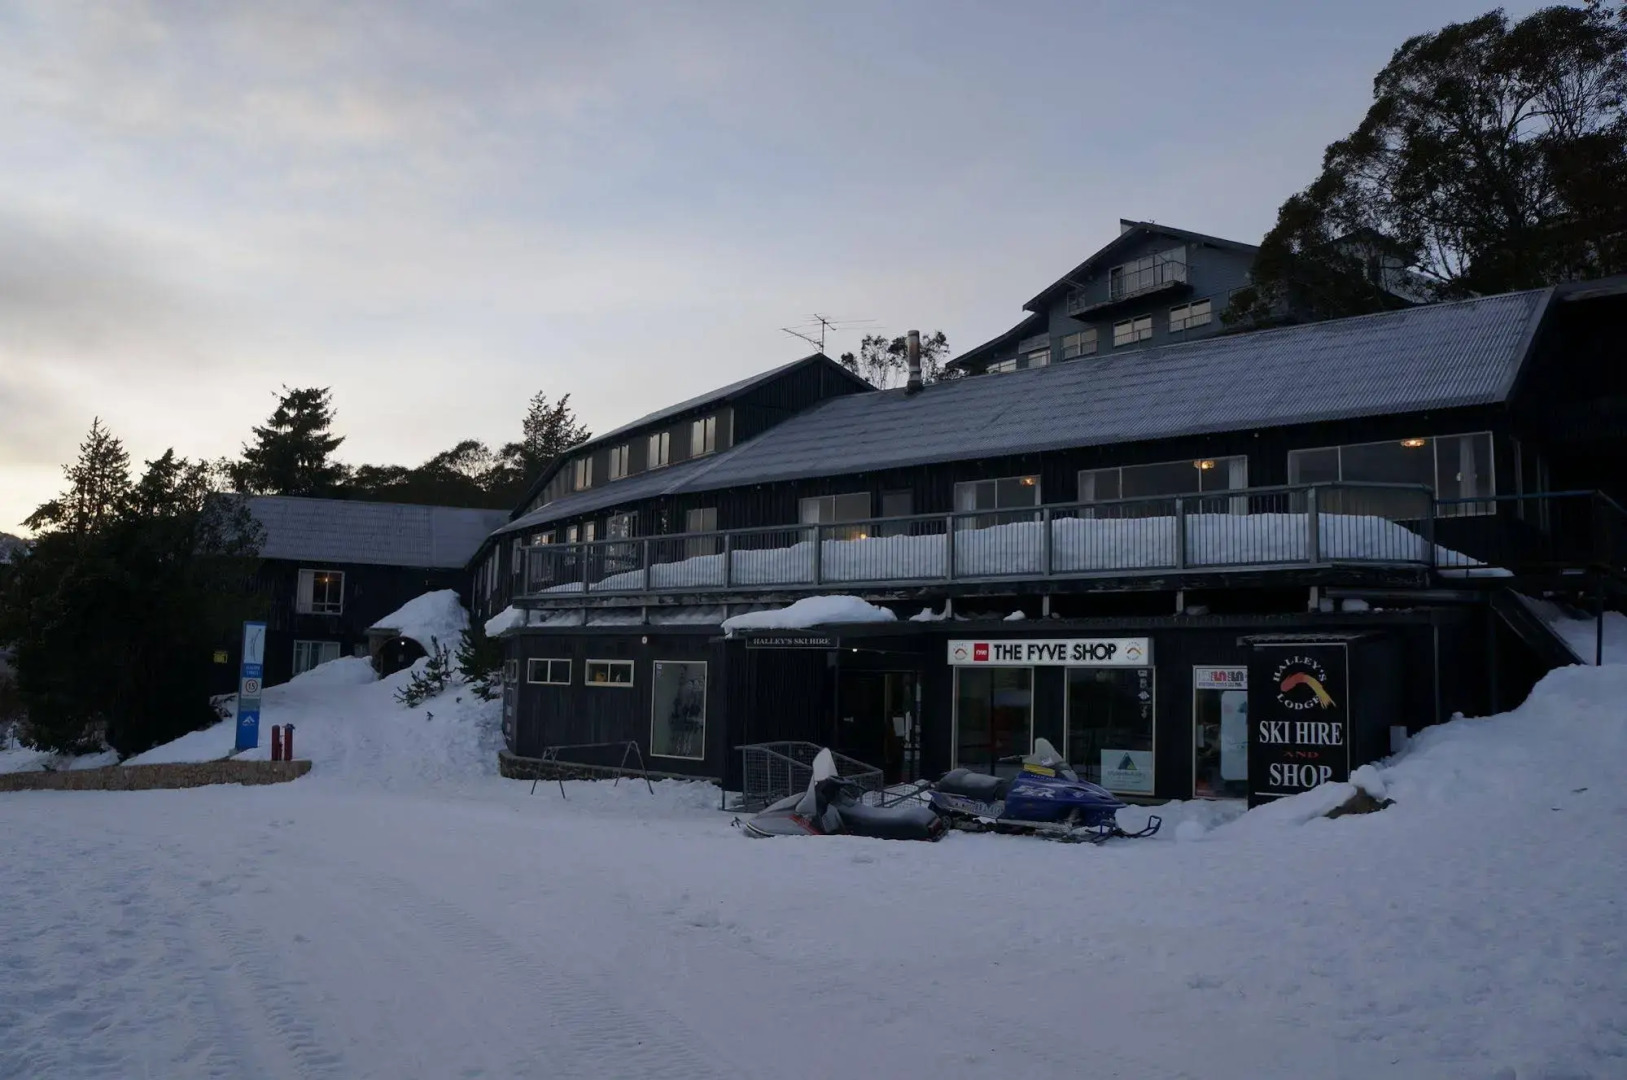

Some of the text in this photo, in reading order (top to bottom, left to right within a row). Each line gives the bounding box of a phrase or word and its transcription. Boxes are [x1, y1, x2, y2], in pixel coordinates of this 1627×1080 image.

[994, 644, 1022, 661] THE
[1027, 644, 1067, 661] FYVE
[1073, 643, 1117, 661] SHOP
[1273, 655, 1327, 683] HALLEY'S
[1277, 693, 1321, 710] LODGE
[1259, 720, 1343, 746] SKI HIRE
[1283, 751, 1319, 759] AND
[1269, 763, 1333, 788] SHOP
